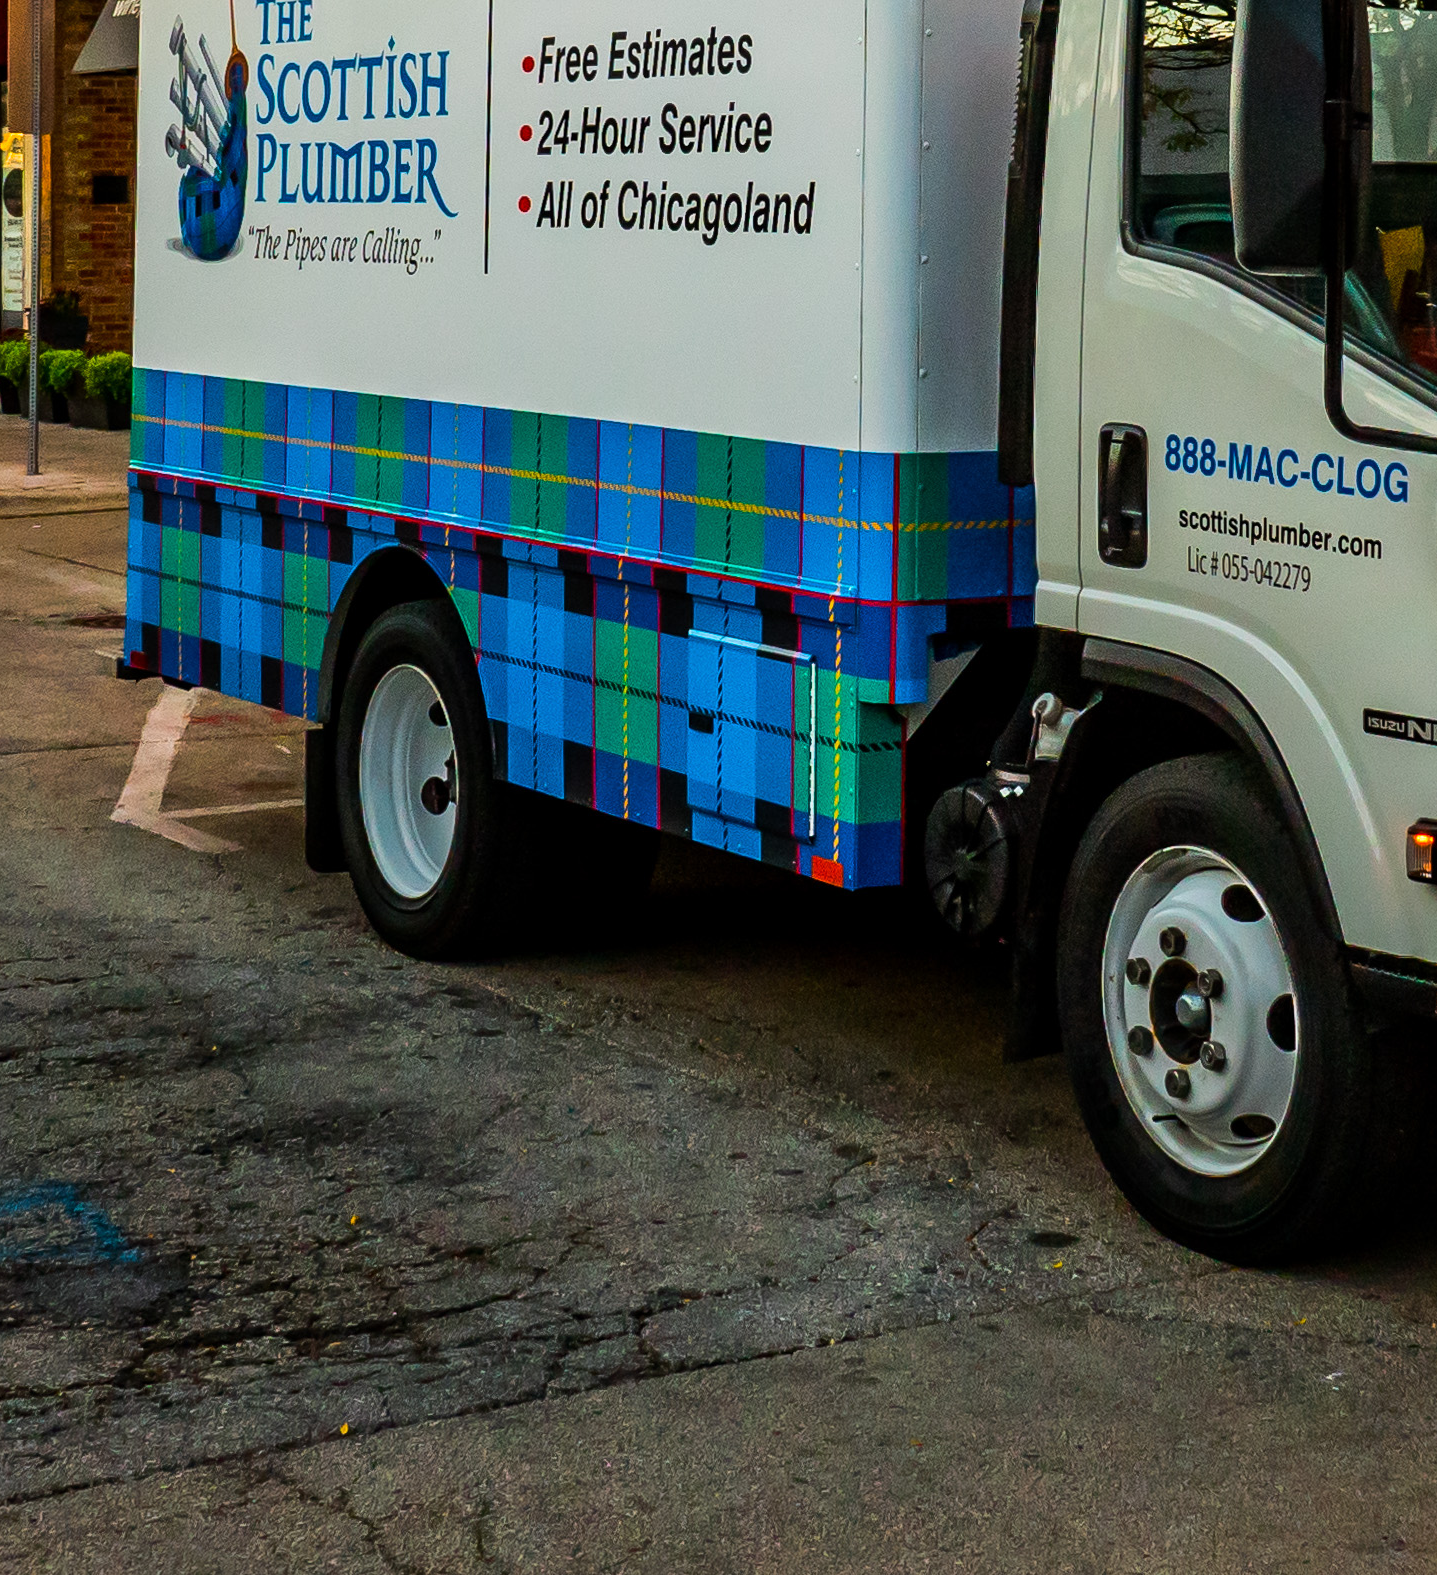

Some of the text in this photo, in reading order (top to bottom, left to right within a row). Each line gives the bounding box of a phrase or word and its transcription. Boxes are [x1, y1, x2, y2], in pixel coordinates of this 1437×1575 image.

[537, 25, 754, 84] Free Estimates
[536, 101, 774, 156] 24-Hour Service
[536, 179, 817, 247] All of Chicagoland
[283, 227, 327, 270] Pipes
[330, 238, 358, 263] are
[1164, 433, 1410, 504] 888-MAC-CLOG
[1178, 508, 1383, 560] scottishplumber.com
[1187, 545, 1312, 593] Lic # 055-042279
[1367, 715, 1406, 734] ISUZU
